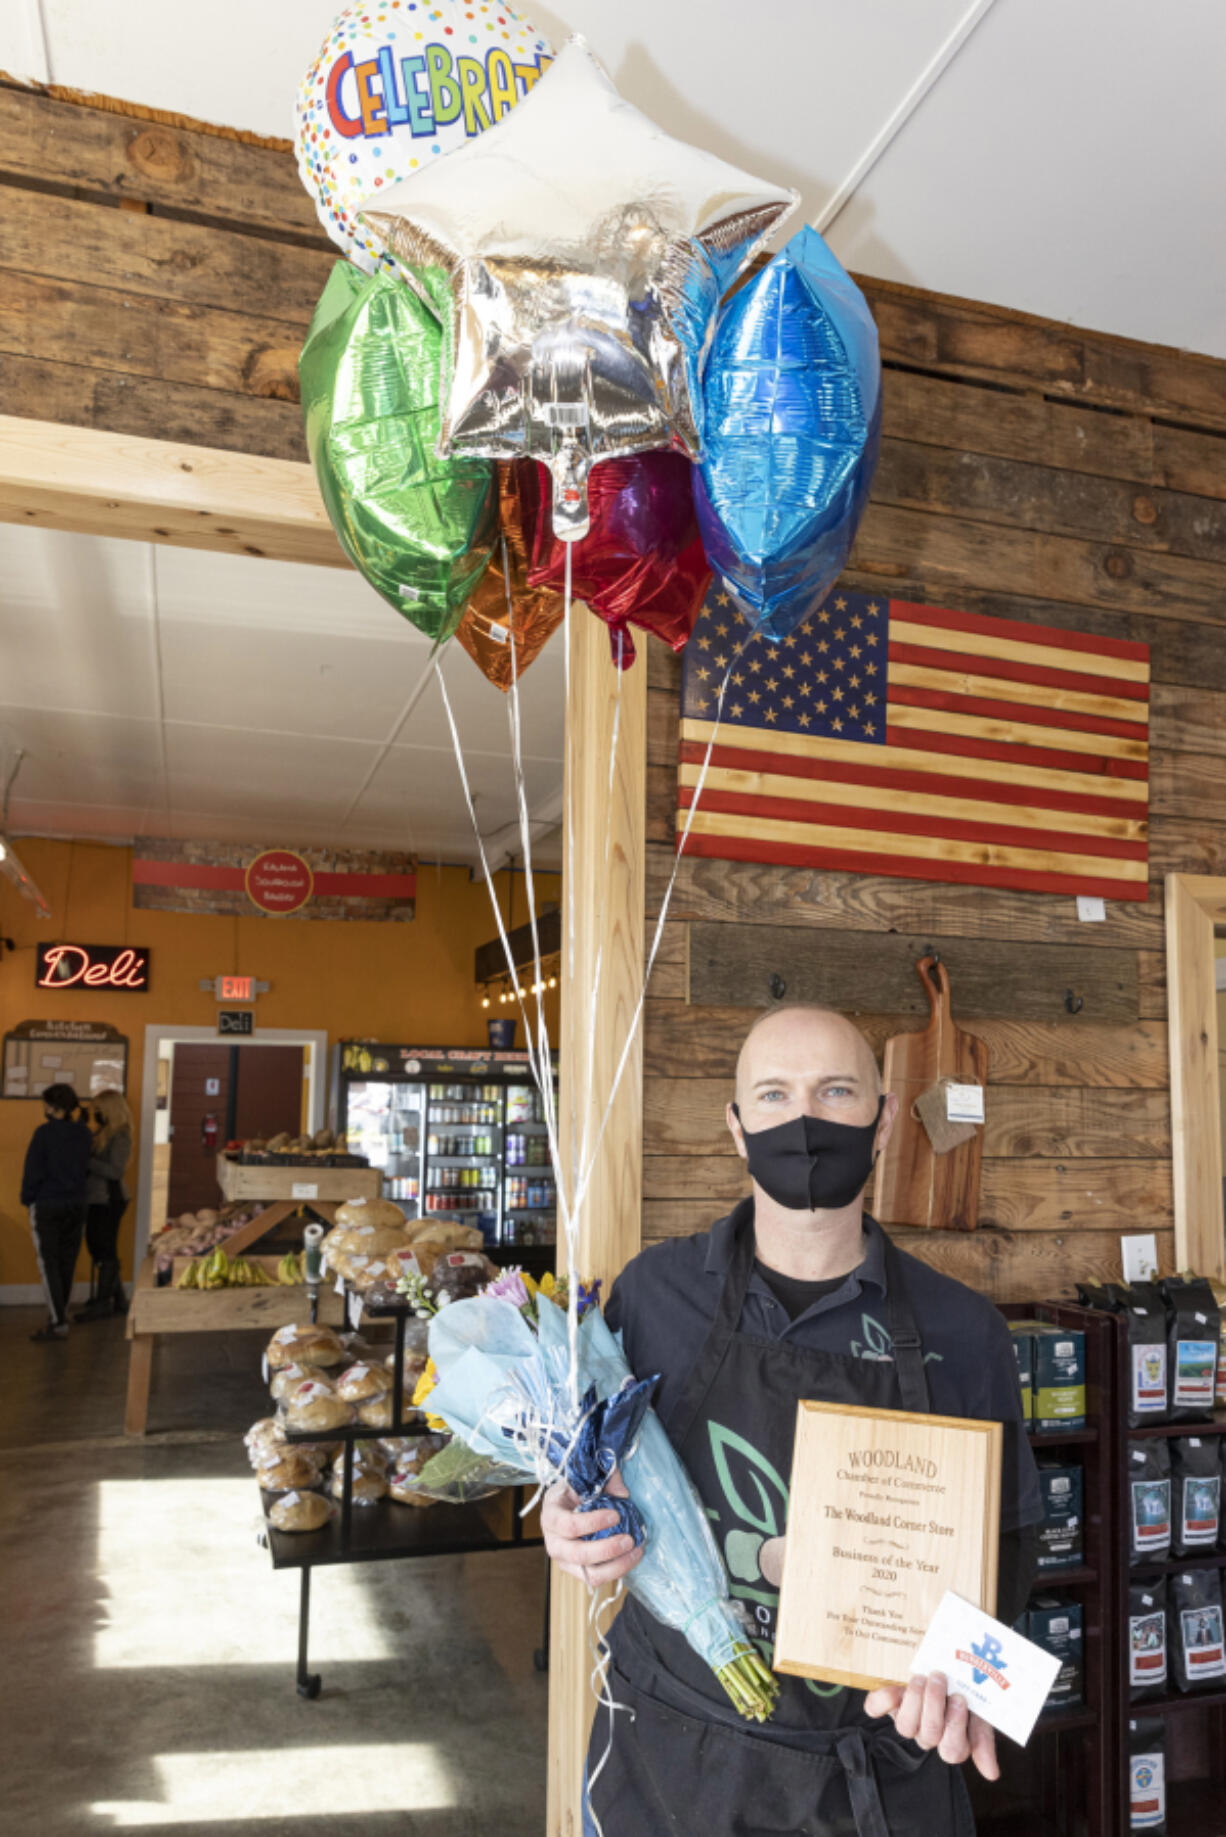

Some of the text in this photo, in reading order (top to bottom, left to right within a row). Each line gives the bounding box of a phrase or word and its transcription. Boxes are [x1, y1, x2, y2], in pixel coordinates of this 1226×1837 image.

[325, 43, 554, 139] CELEBRAT
[38, 945, 144, 988] Deli
[222, 977, 251, 999] EXIT
[221, 1014, 249, 1031] Deli
[401, 1049, 445, 1059] LOCAL
[447, 1050, 491, 1061] CRAFT
[848, 1449, 938, 1479] WOODLAND
[836, 1468, 946, 1494] Chamber of Commerce
[824, 1505, 955, 1537] The Woodland Corner Store
[832, 1546, 940, 1574] Business of the Year
[871, 1567, 897, 1582] 2020
[862, 1605, 885, 1617] Thank
